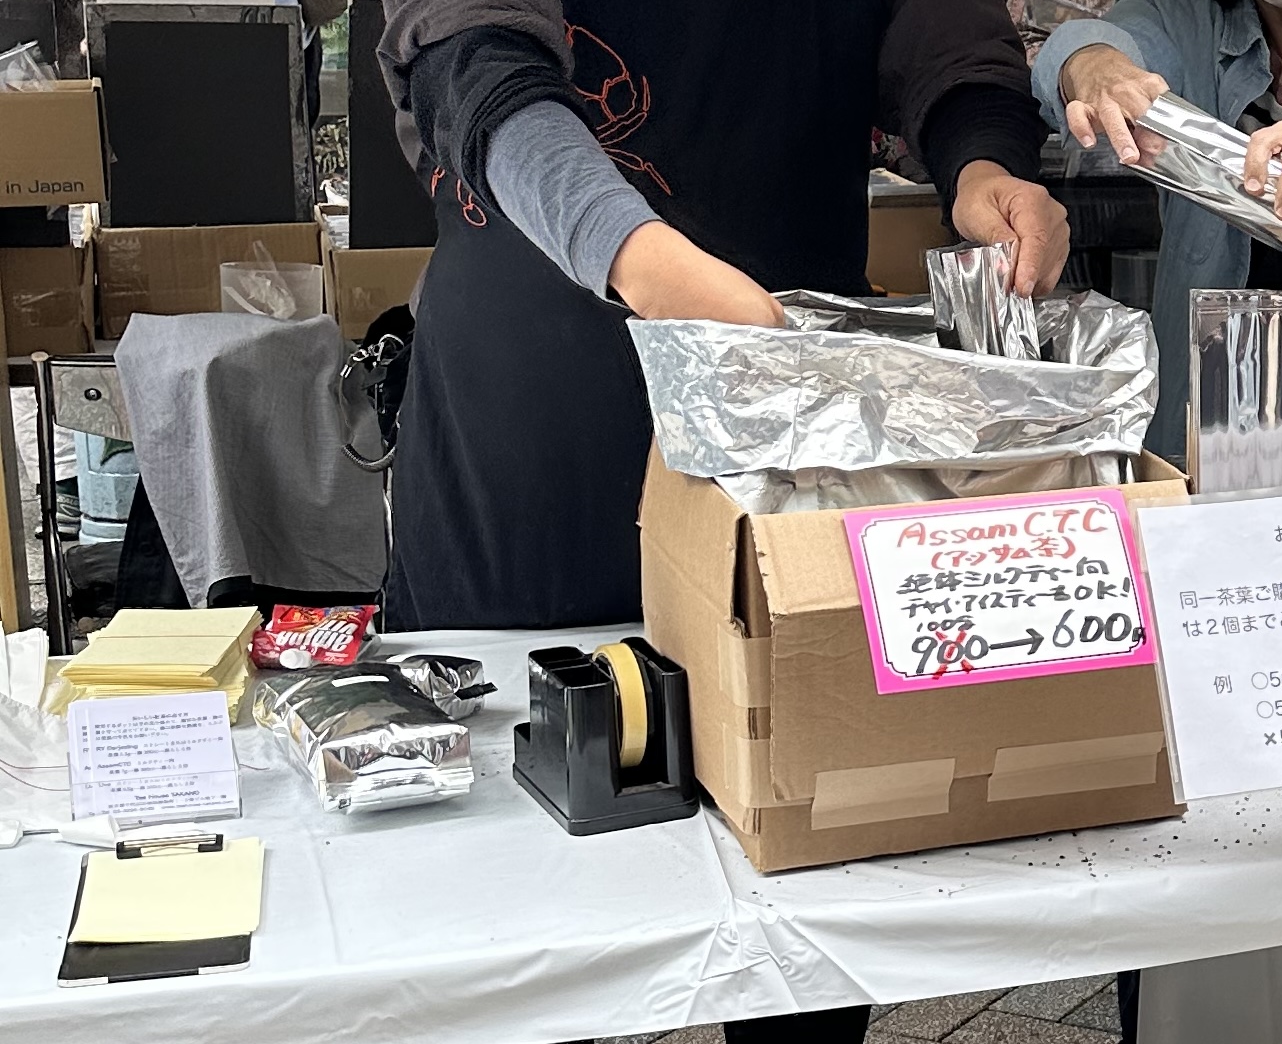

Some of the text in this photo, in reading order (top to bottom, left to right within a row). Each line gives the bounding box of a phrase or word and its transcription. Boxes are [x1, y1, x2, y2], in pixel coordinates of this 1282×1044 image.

[5, 179, 85, 195] in Japan
[896, 521, 1018, 548] Assam
[1213, 674, 1233, 694] 例
